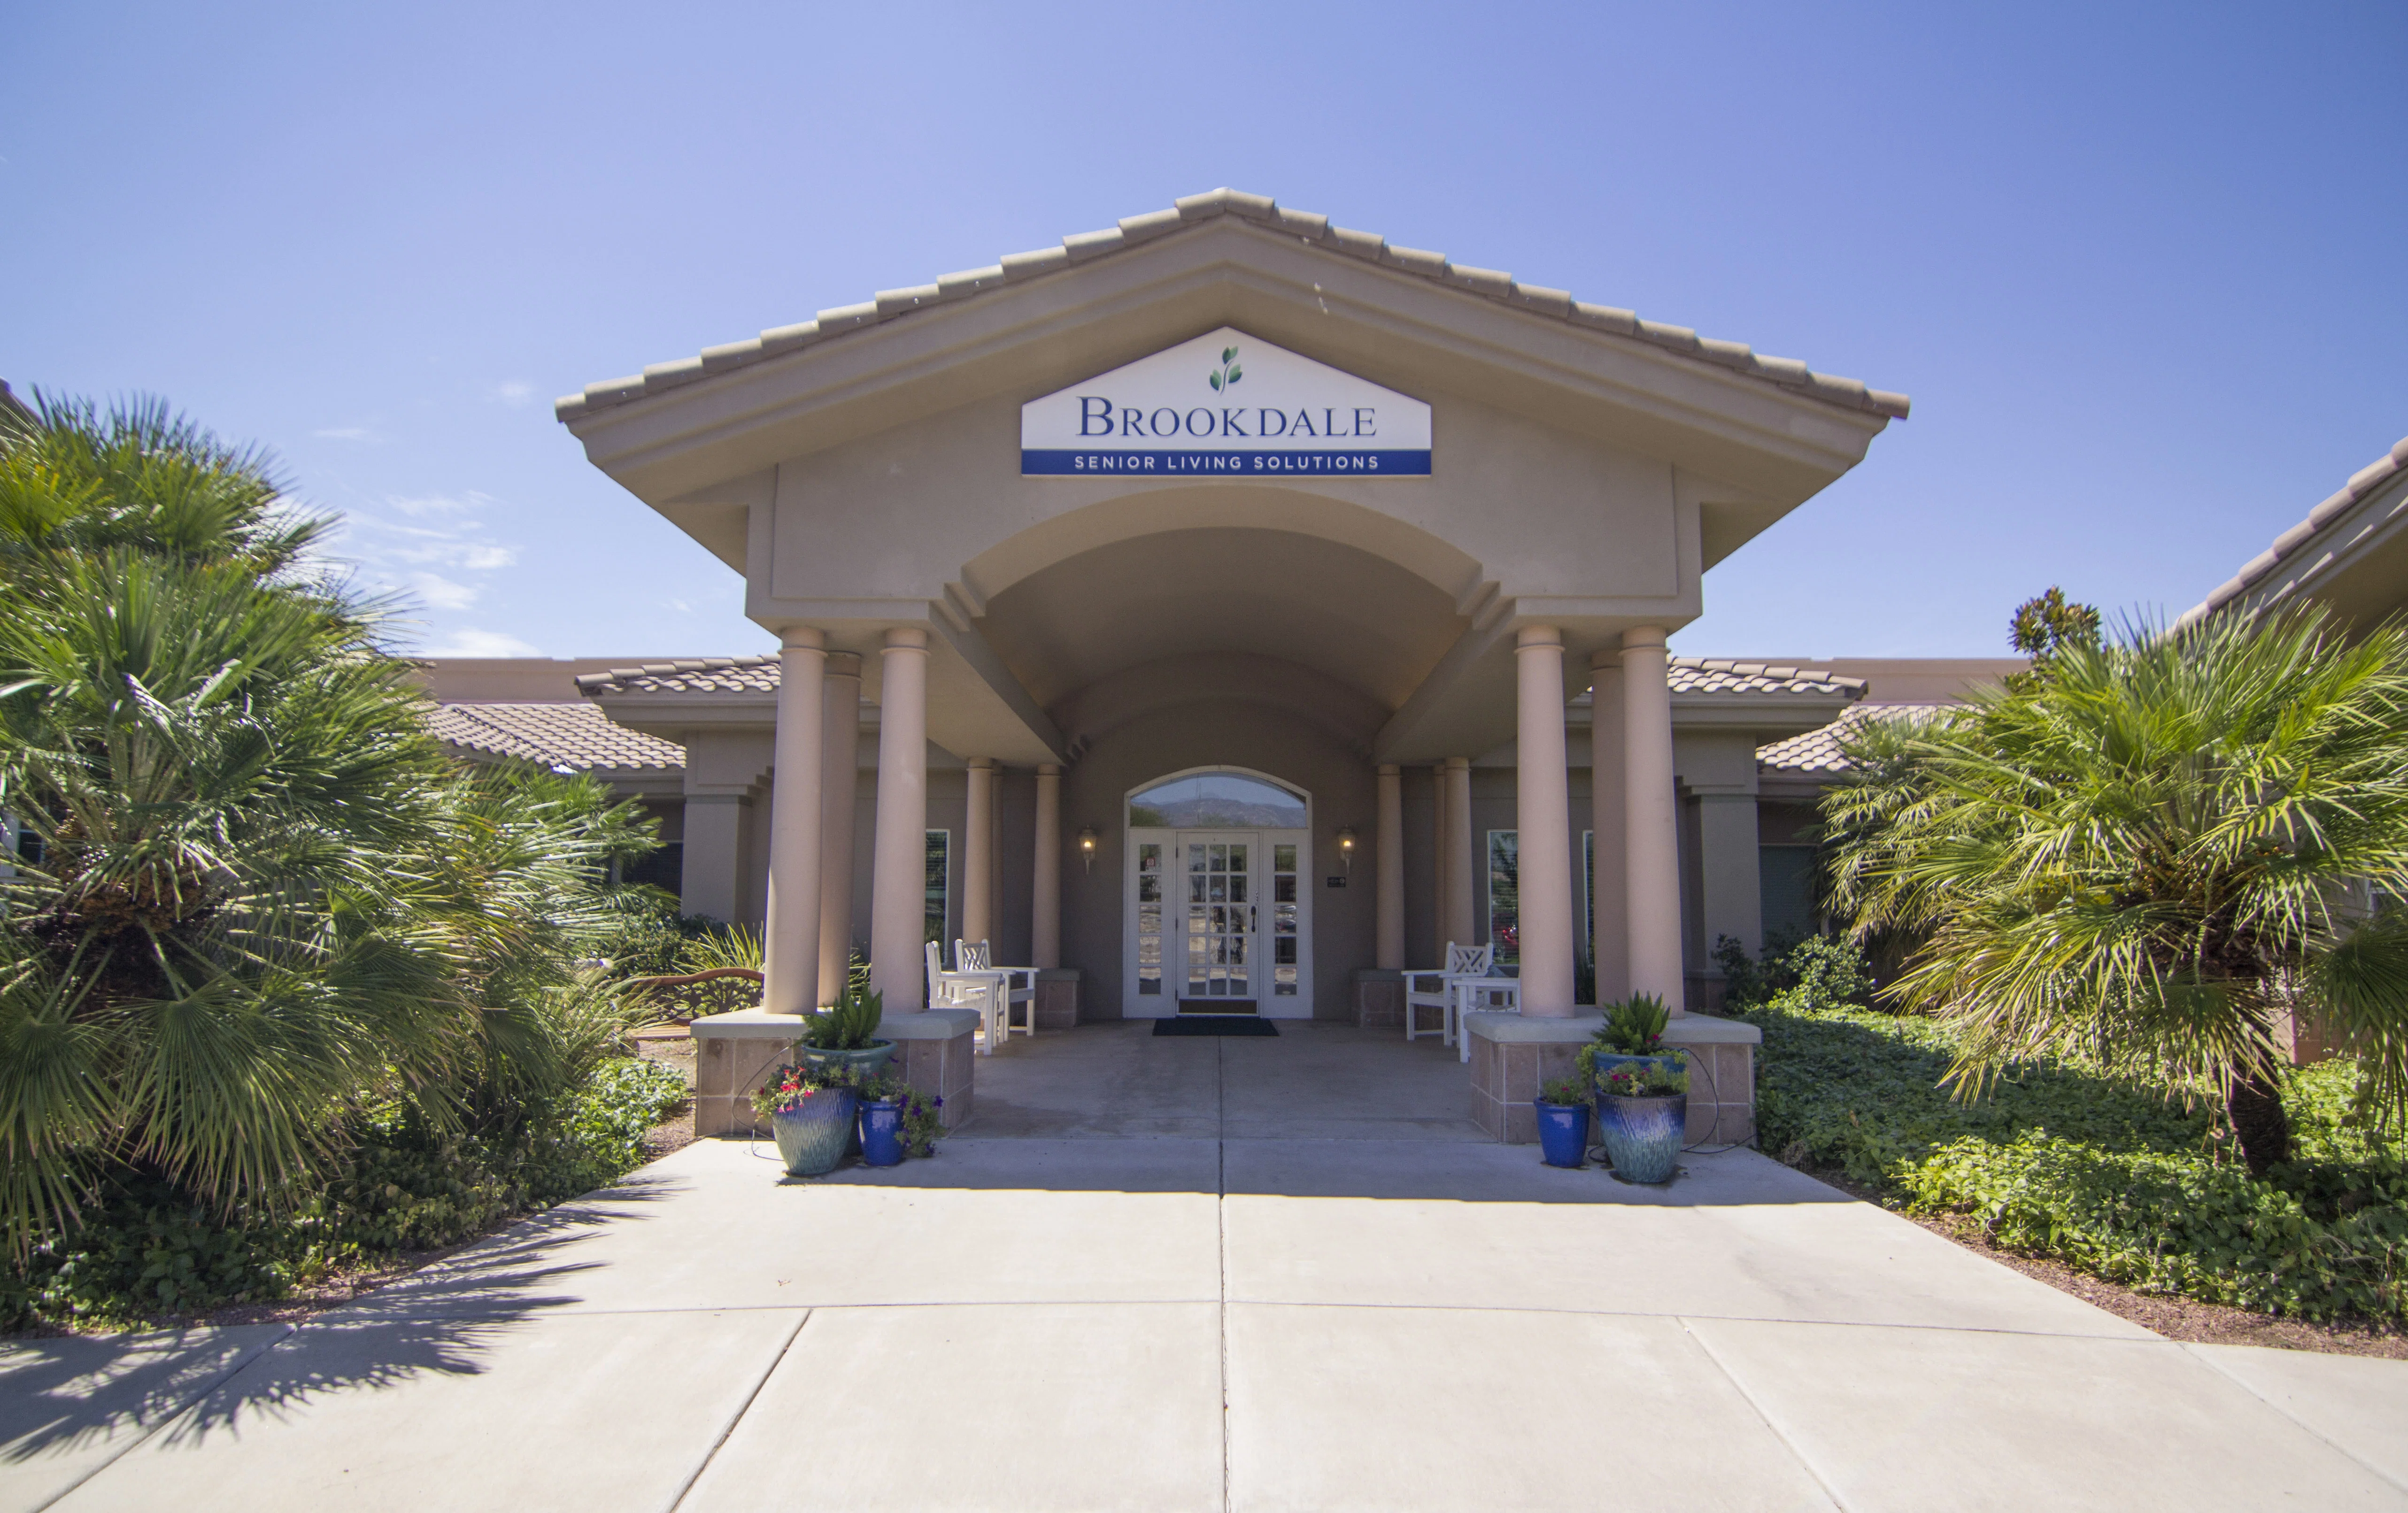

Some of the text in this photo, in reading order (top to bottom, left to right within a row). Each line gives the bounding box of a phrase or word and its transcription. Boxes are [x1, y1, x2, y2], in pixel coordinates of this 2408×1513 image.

[1076, 396, 1377, 436] BROOKDALE
[1075, 456, 1378, 468] SENIOR LIVING SOLUTIONS
